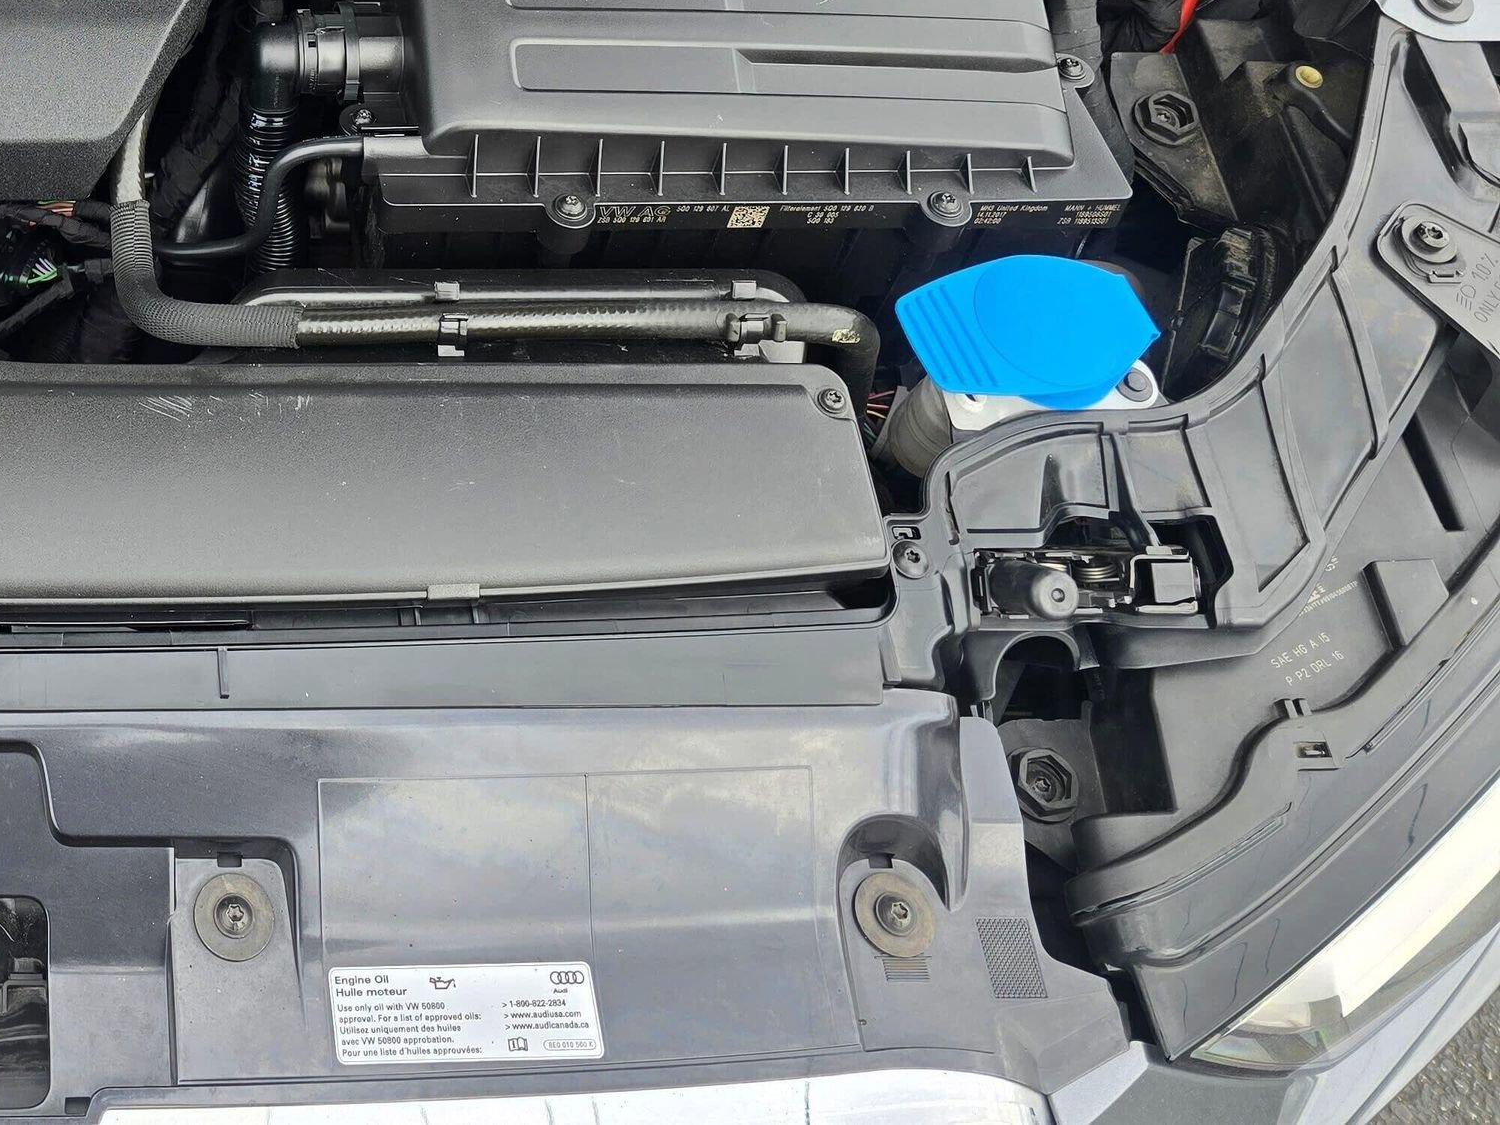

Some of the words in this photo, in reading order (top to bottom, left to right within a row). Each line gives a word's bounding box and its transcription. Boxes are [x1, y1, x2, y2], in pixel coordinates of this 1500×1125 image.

[600, 206, 637, 217] VW
[638, 206, 672, 217] AG
[1020, 205, 1049, 213] Kingdom
[1270, 651, 1293, 669] SAE
[1292, 643, 1308, 658] HG
[1309, 639, 1319, 649] A
[1318, 632, 1331, 644] 15
[1285, 676, 1293, 686] P
[1295, 668, 1312, 681] P2
[1310, 659, 1332, 673] DRL
[1332, 650, 1344, 661] 16
[334, 975, 371, 987] Engine
[374, 975, 389, 984] Oil
[336, 987, 363, 997] Huile
[366, 987, 407, 997] moteur
[337, 1004, 353, 1012] Use
[354, 1003, 372, 1014] only
[375, 1003, 384, 1012] oil
[386, 1002, 404, 1011] with
[405, 1002, 420, 1011] VW
[509, 999, 566, 1008] 1-800-822-2834
[339, 1015, 376, 1024] approval.
[378, 1014, 391, 1022] For
[400, 1013, 413, 1022] list
[414, 1013, 423, 1021] of
[425, 1013, 462, 1023] approved
[464, 1012, 482, 1021] oils:
[510, 1011, 582, 1019] www.audiusa.com
[340, 1026, 369, 1035] Utilisez
[371, 1025, 418, 1035] uniquement
[420, 1024, 434, 1032] des
[437, 1024, 461, 1032] huiles
[512, 1021, 589, 1030] www.audicanada.ca
[342, 1038, 359, 1046] avec
[361, 1037, 375, 1045] VW
[403, 1035, 455, 1045] approbation.
[342, 1048, 361, 1057] Pour
[362, 1049, 378, 1057] une
[379, 1047, 398, 1056] liste
[433, 1045, 483, 1056] approuvées:
